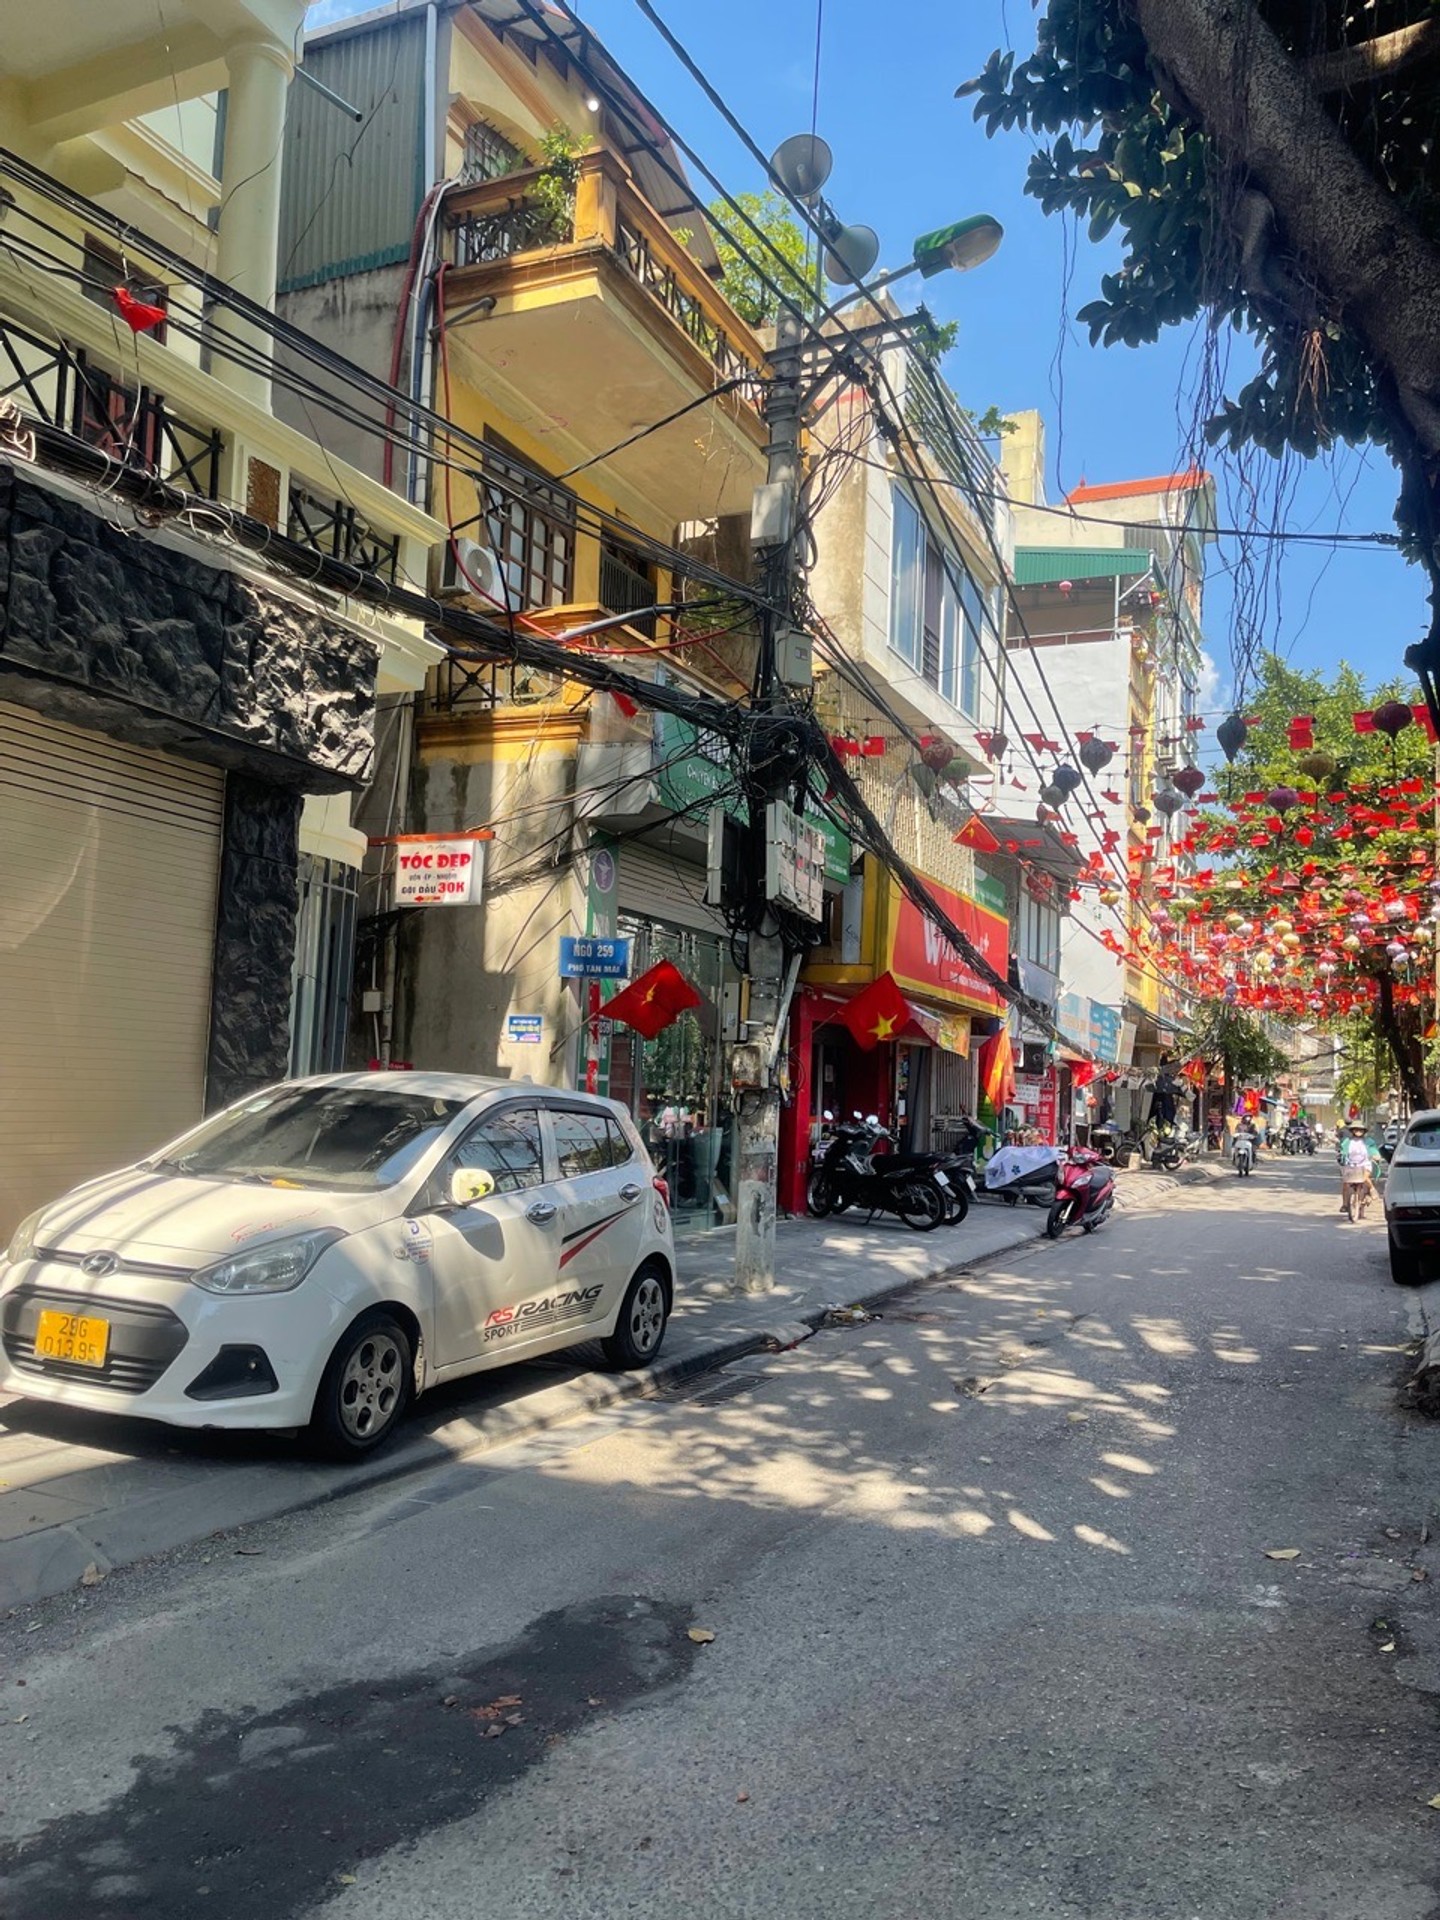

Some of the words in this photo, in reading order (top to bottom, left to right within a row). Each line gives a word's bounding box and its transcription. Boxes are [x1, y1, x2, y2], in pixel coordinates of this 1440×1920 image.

[400, 852, 433, 869] TÓC
[438, 882, 464, 893] 30K
[597, 944, 614, 957] 259
[485, 1307, 514, 1326] RS
[514, 1284, 604, 1319] RACING
[483, 1323, 520, 1342] SPORT
